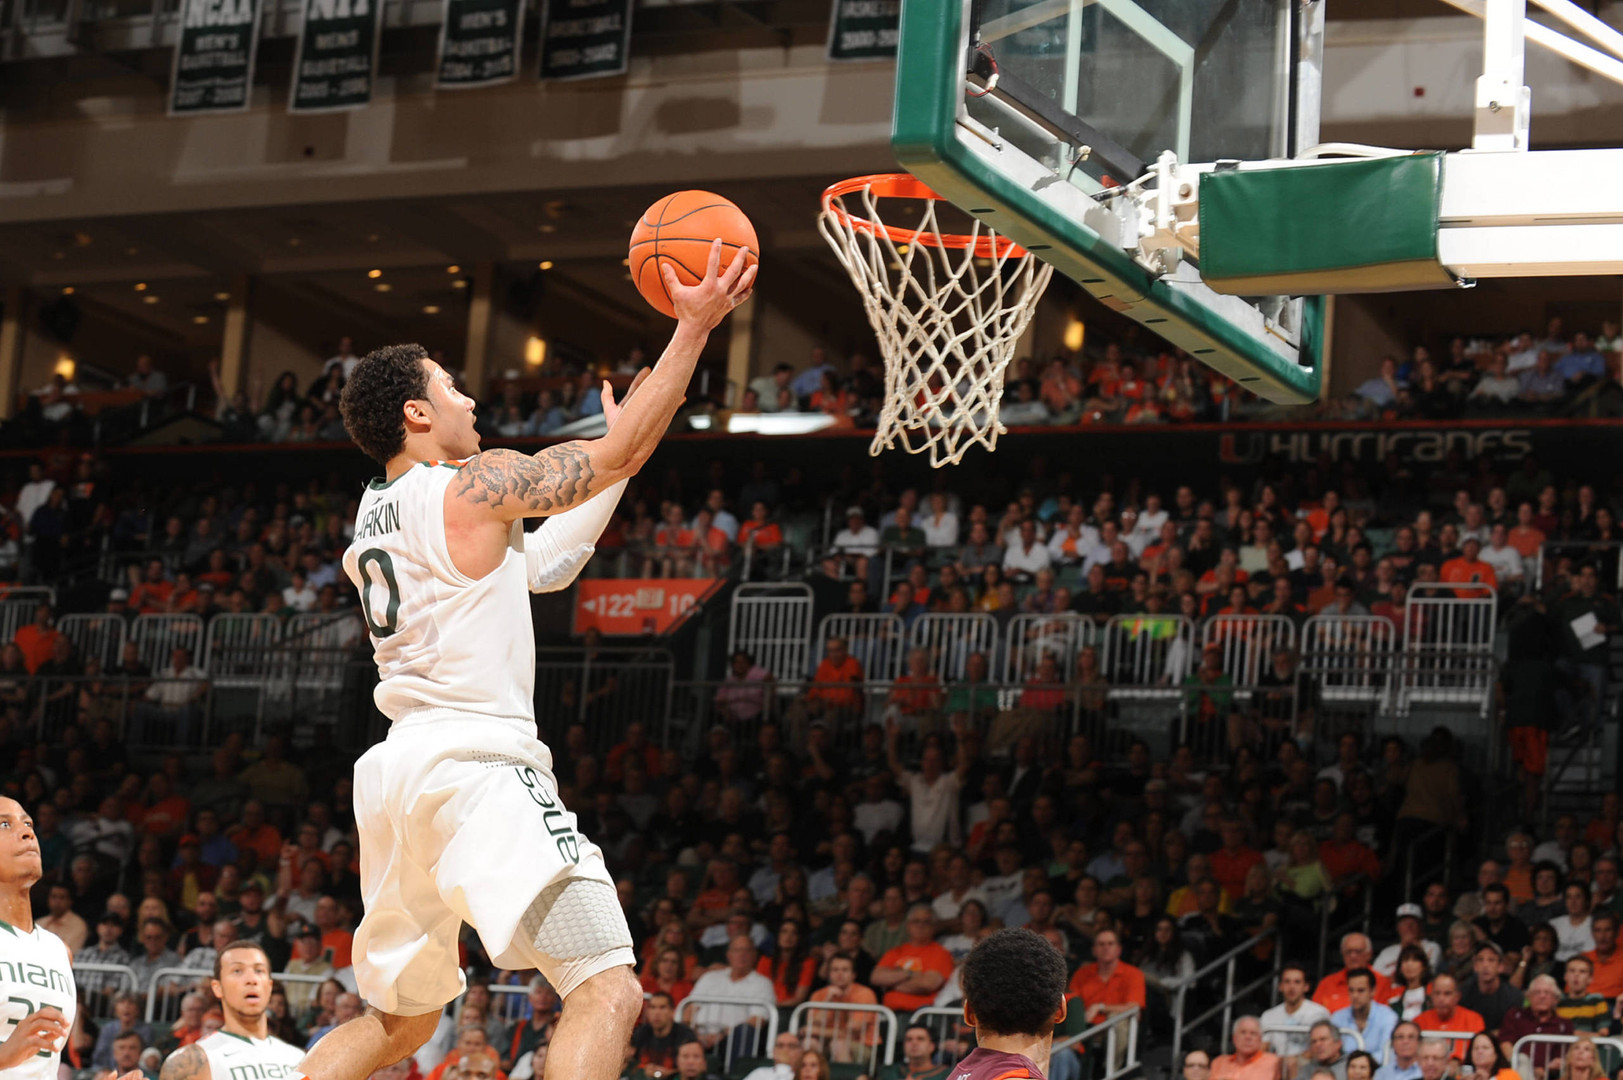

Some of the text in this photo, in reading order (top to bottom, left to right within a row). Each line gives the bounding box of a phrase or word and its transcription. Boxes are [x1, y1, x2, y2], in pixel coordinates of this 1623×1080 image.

[352, 500, 400, 543] ARKIN
[358, 548, 401, 638] 0
[598, 593, 635, 617] 122
